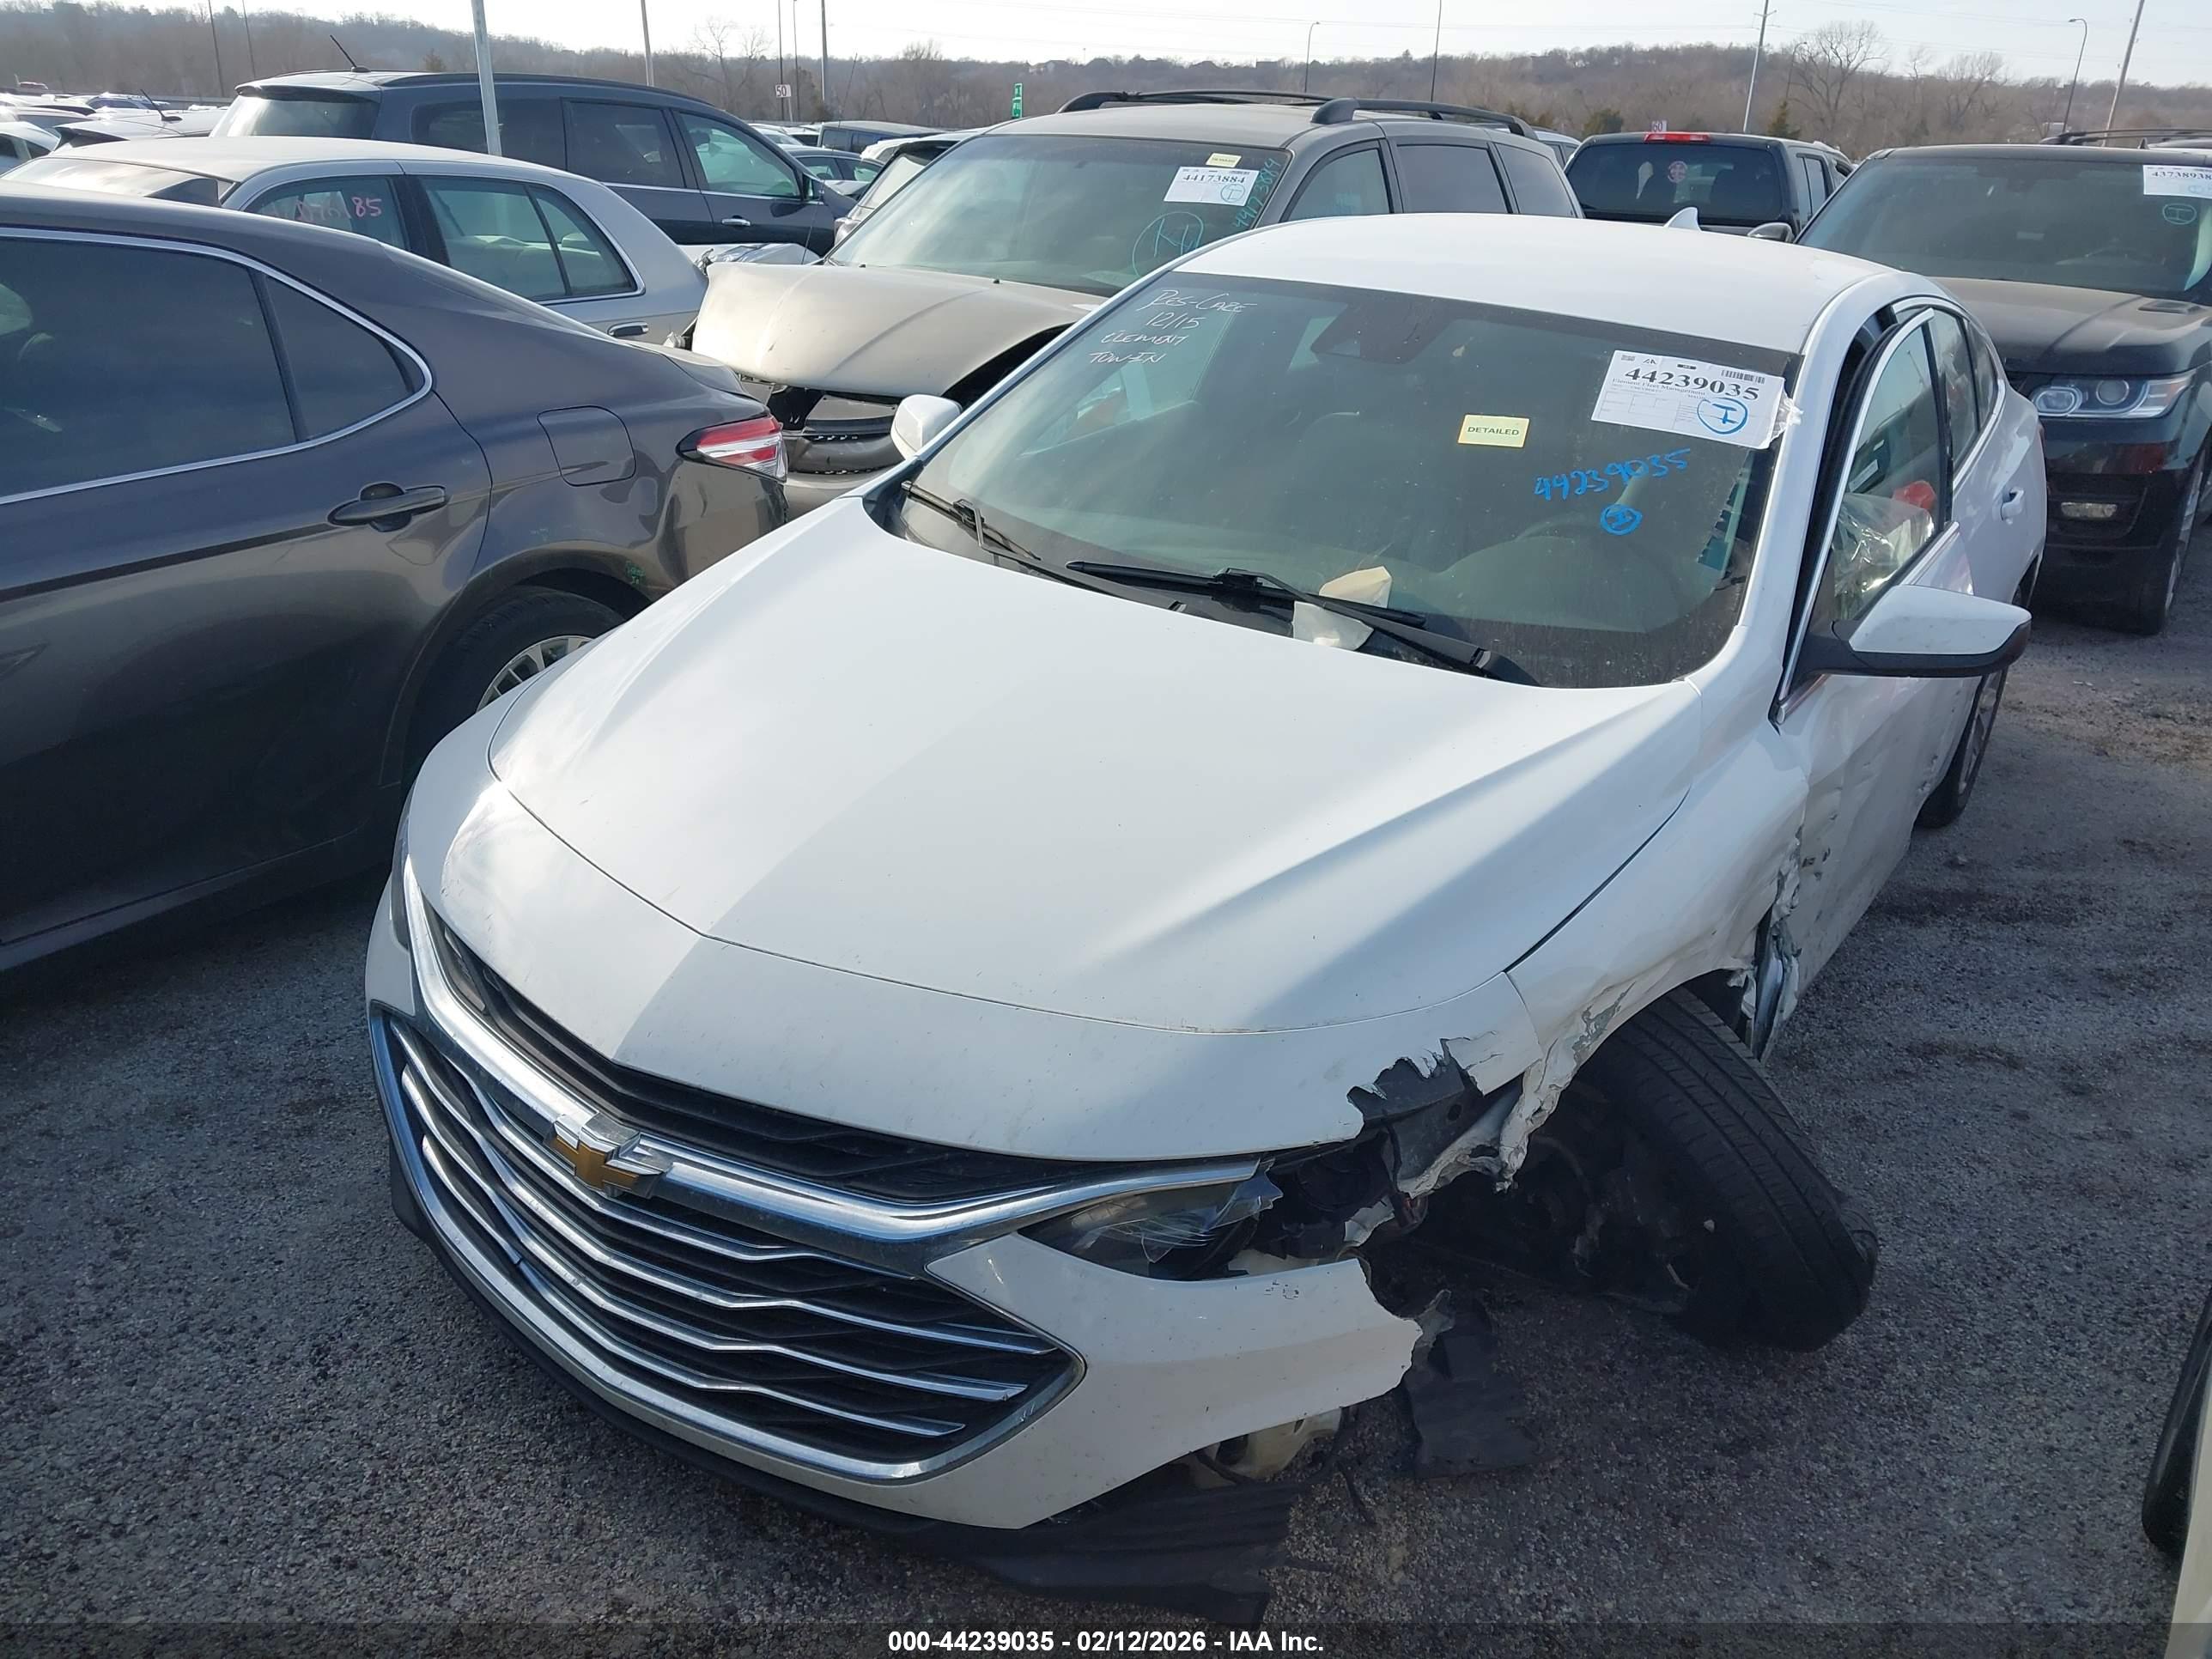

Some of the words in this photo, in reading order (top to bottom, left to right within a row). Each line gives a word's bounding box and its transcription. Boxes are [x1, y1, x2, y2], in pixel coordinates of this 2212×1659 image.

[776, 85, 787, 97] 50
[1182, 173, 1247, 184] 44173884
[1145, 311, 1206, 330] 12/15
[1625, 368, 1759, 401] 44239035
[1467, 426, 1520, 435] DETAILED
[1533, 447, 1691, 501] 44239035
